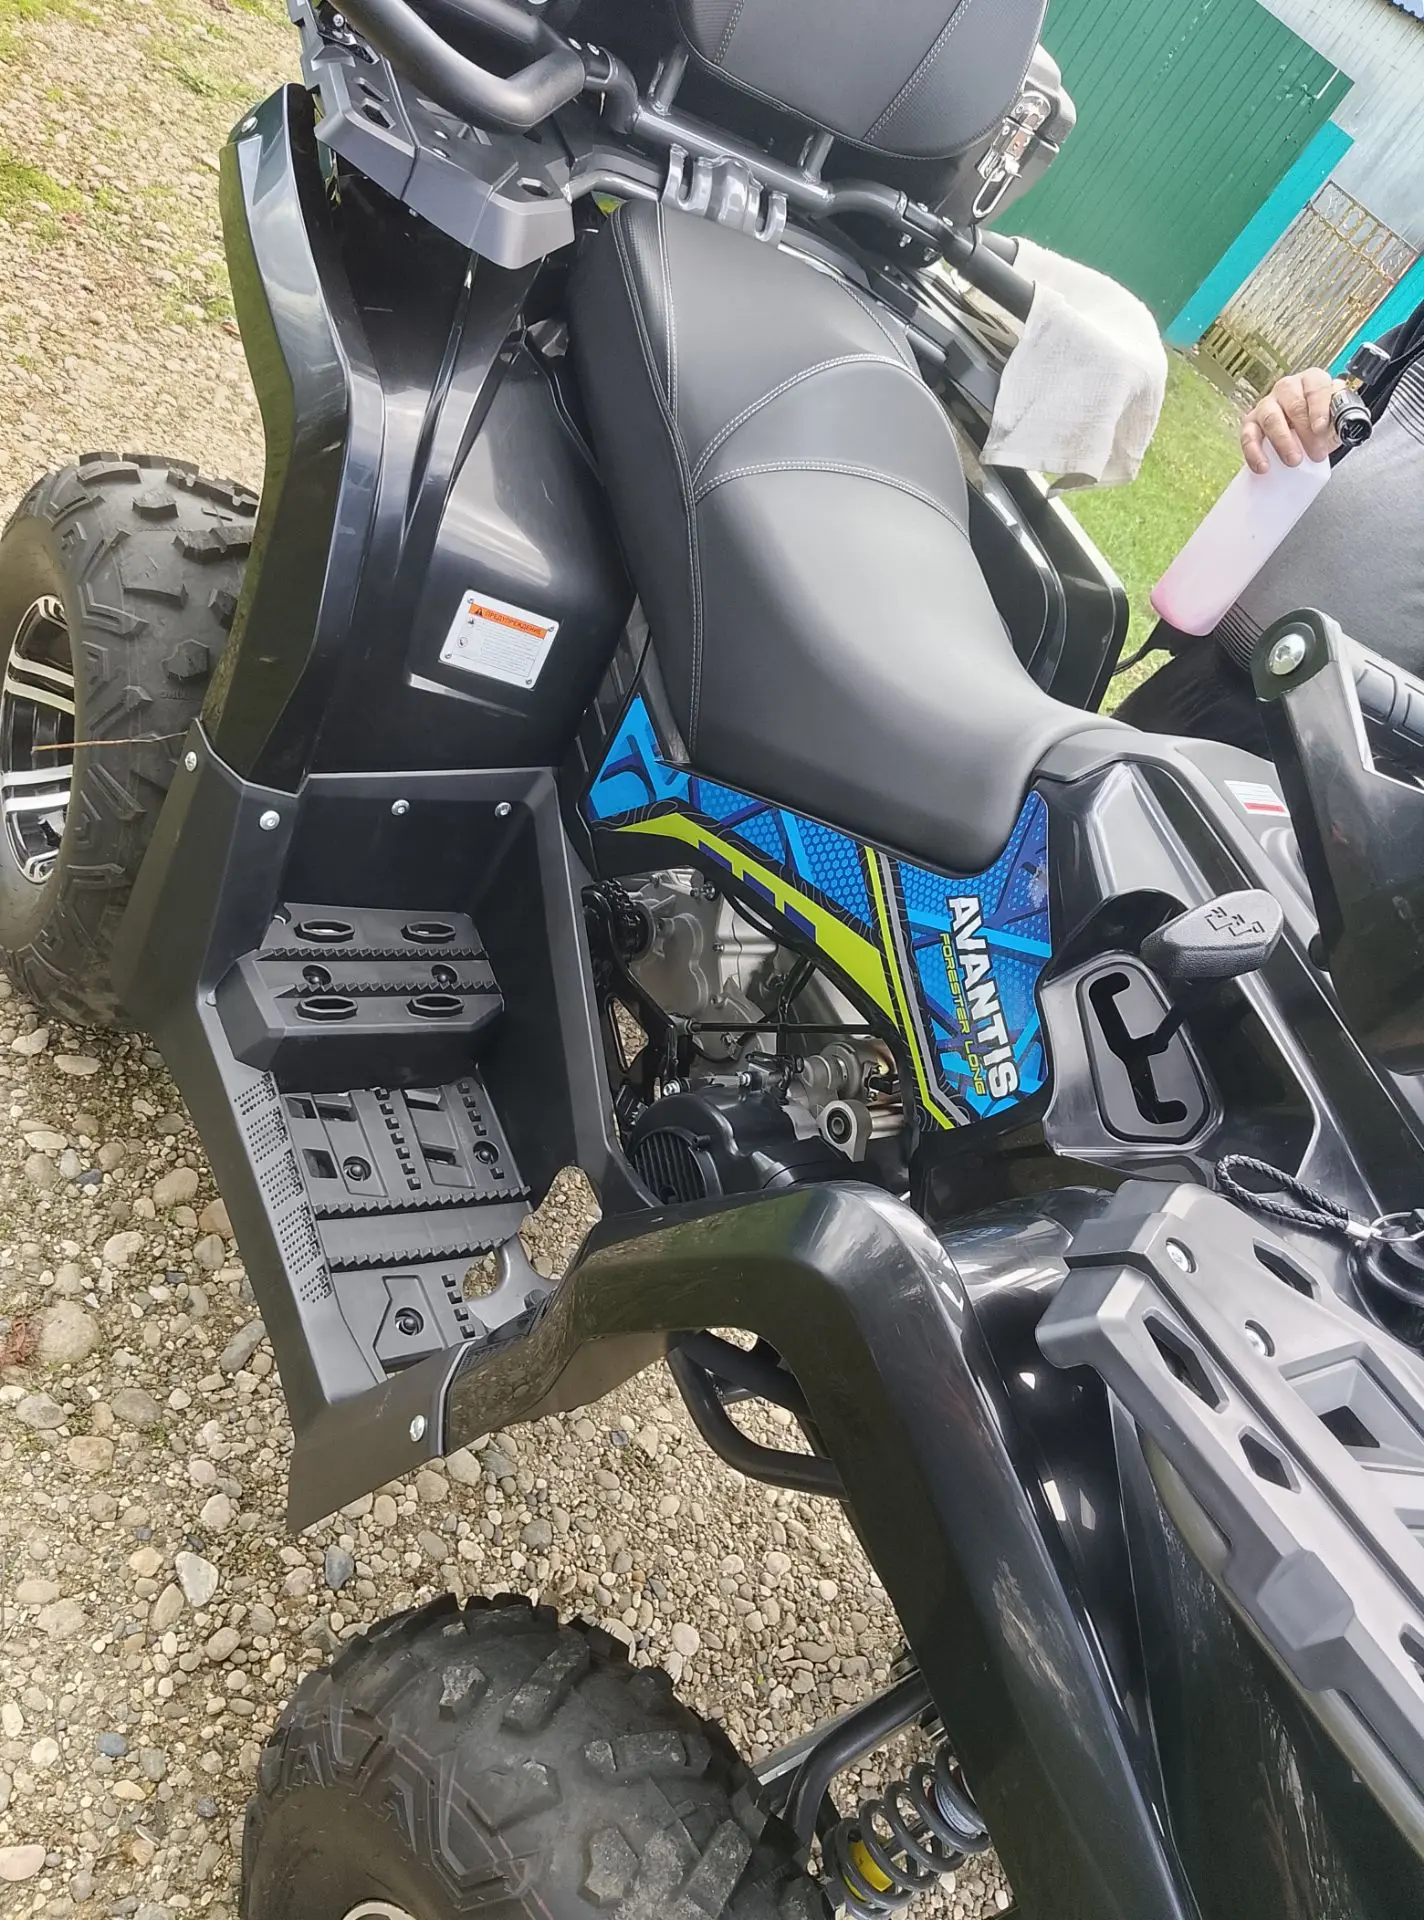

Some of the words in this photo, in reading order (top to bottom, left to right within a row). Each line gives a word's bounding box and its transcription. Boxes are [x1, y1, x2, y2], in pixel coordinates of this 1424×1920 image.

[940, 933, 970, 1033] FORESTER
[964, 1041, 986, 1095] LONG
[948, 896, 1018, 1098] AVANTIS
